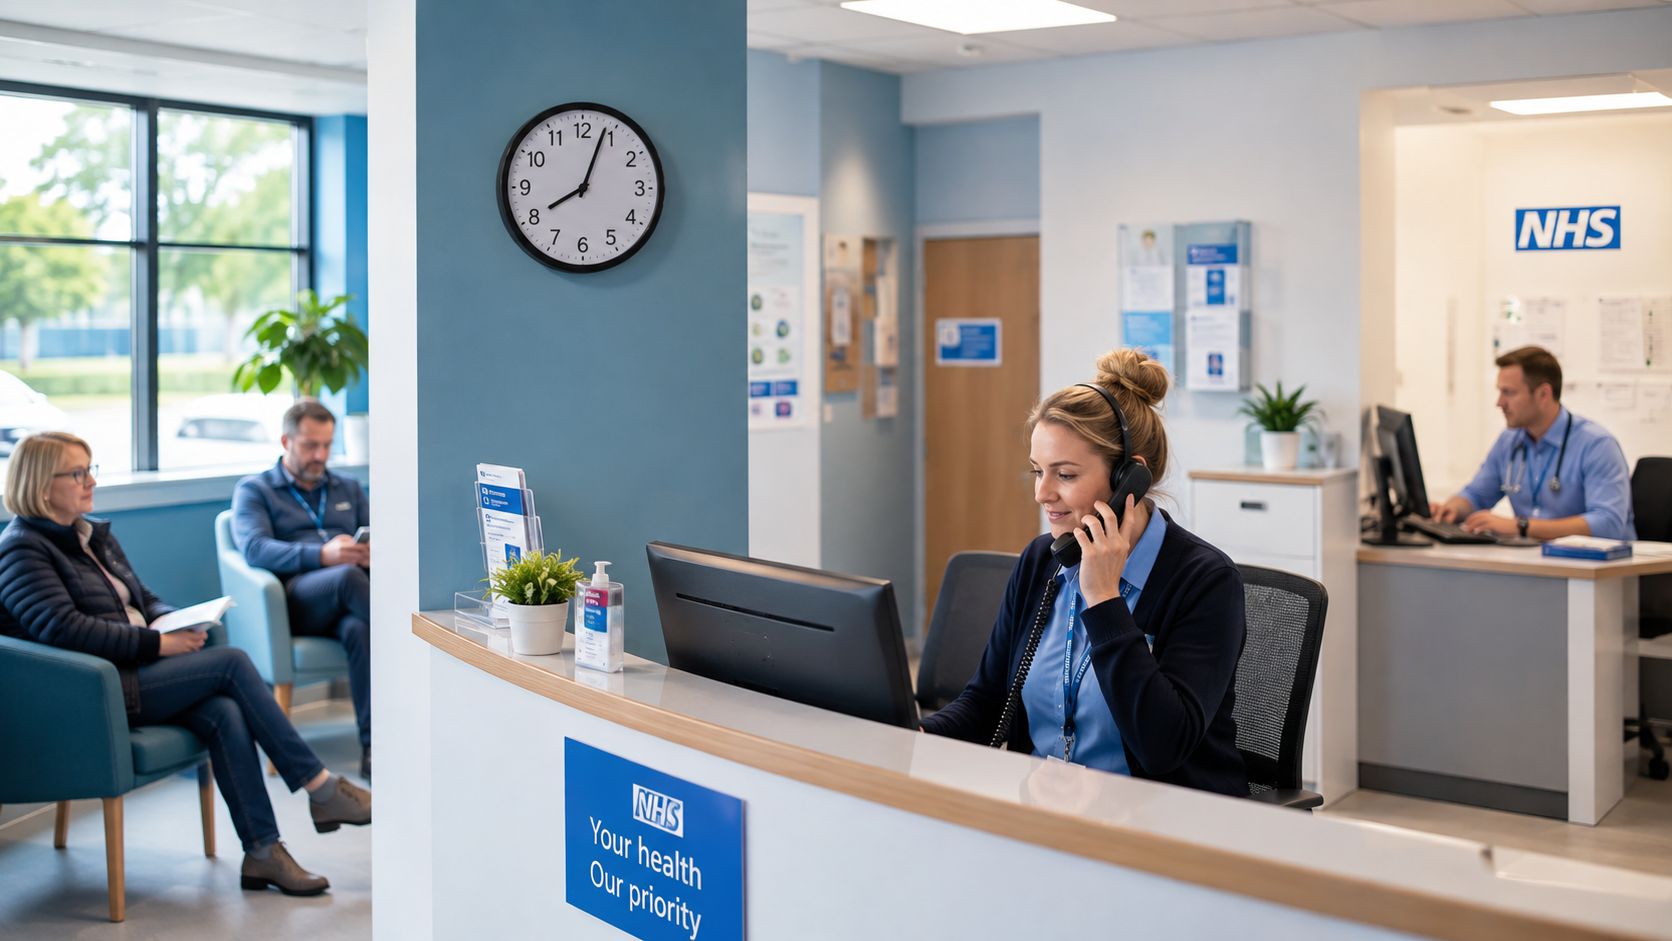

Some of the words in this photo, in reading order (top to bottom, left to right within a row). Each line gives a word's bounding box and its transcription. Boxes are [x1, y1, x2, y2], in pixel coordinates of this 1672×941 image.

[548, 130, 563, 146] 11
[573, 122, 592, 139] 12
[607, 131, 614, 147] 1
[527, 151, 545, 168] 10
[625, 151, 637, 168] 2
[519, 179, 531, 196] 9
[634, 180, 646, 197] 3
[528, 208, 540, 225] 8
[625, 209, 636, 225] 4
[1517, 208, 1617, 249] NHS
[550, 229, 561, 246] 7
[577, 236, 589, 253] 6
[605, 230, 617, 246] 5
[634, 788, 681, 832] NHS
[589, 815, 632, 859] Your
[638, 835, 702, 890] health
[590, 860, 624, 897] Our
[629, 883, 702, 940] priority
